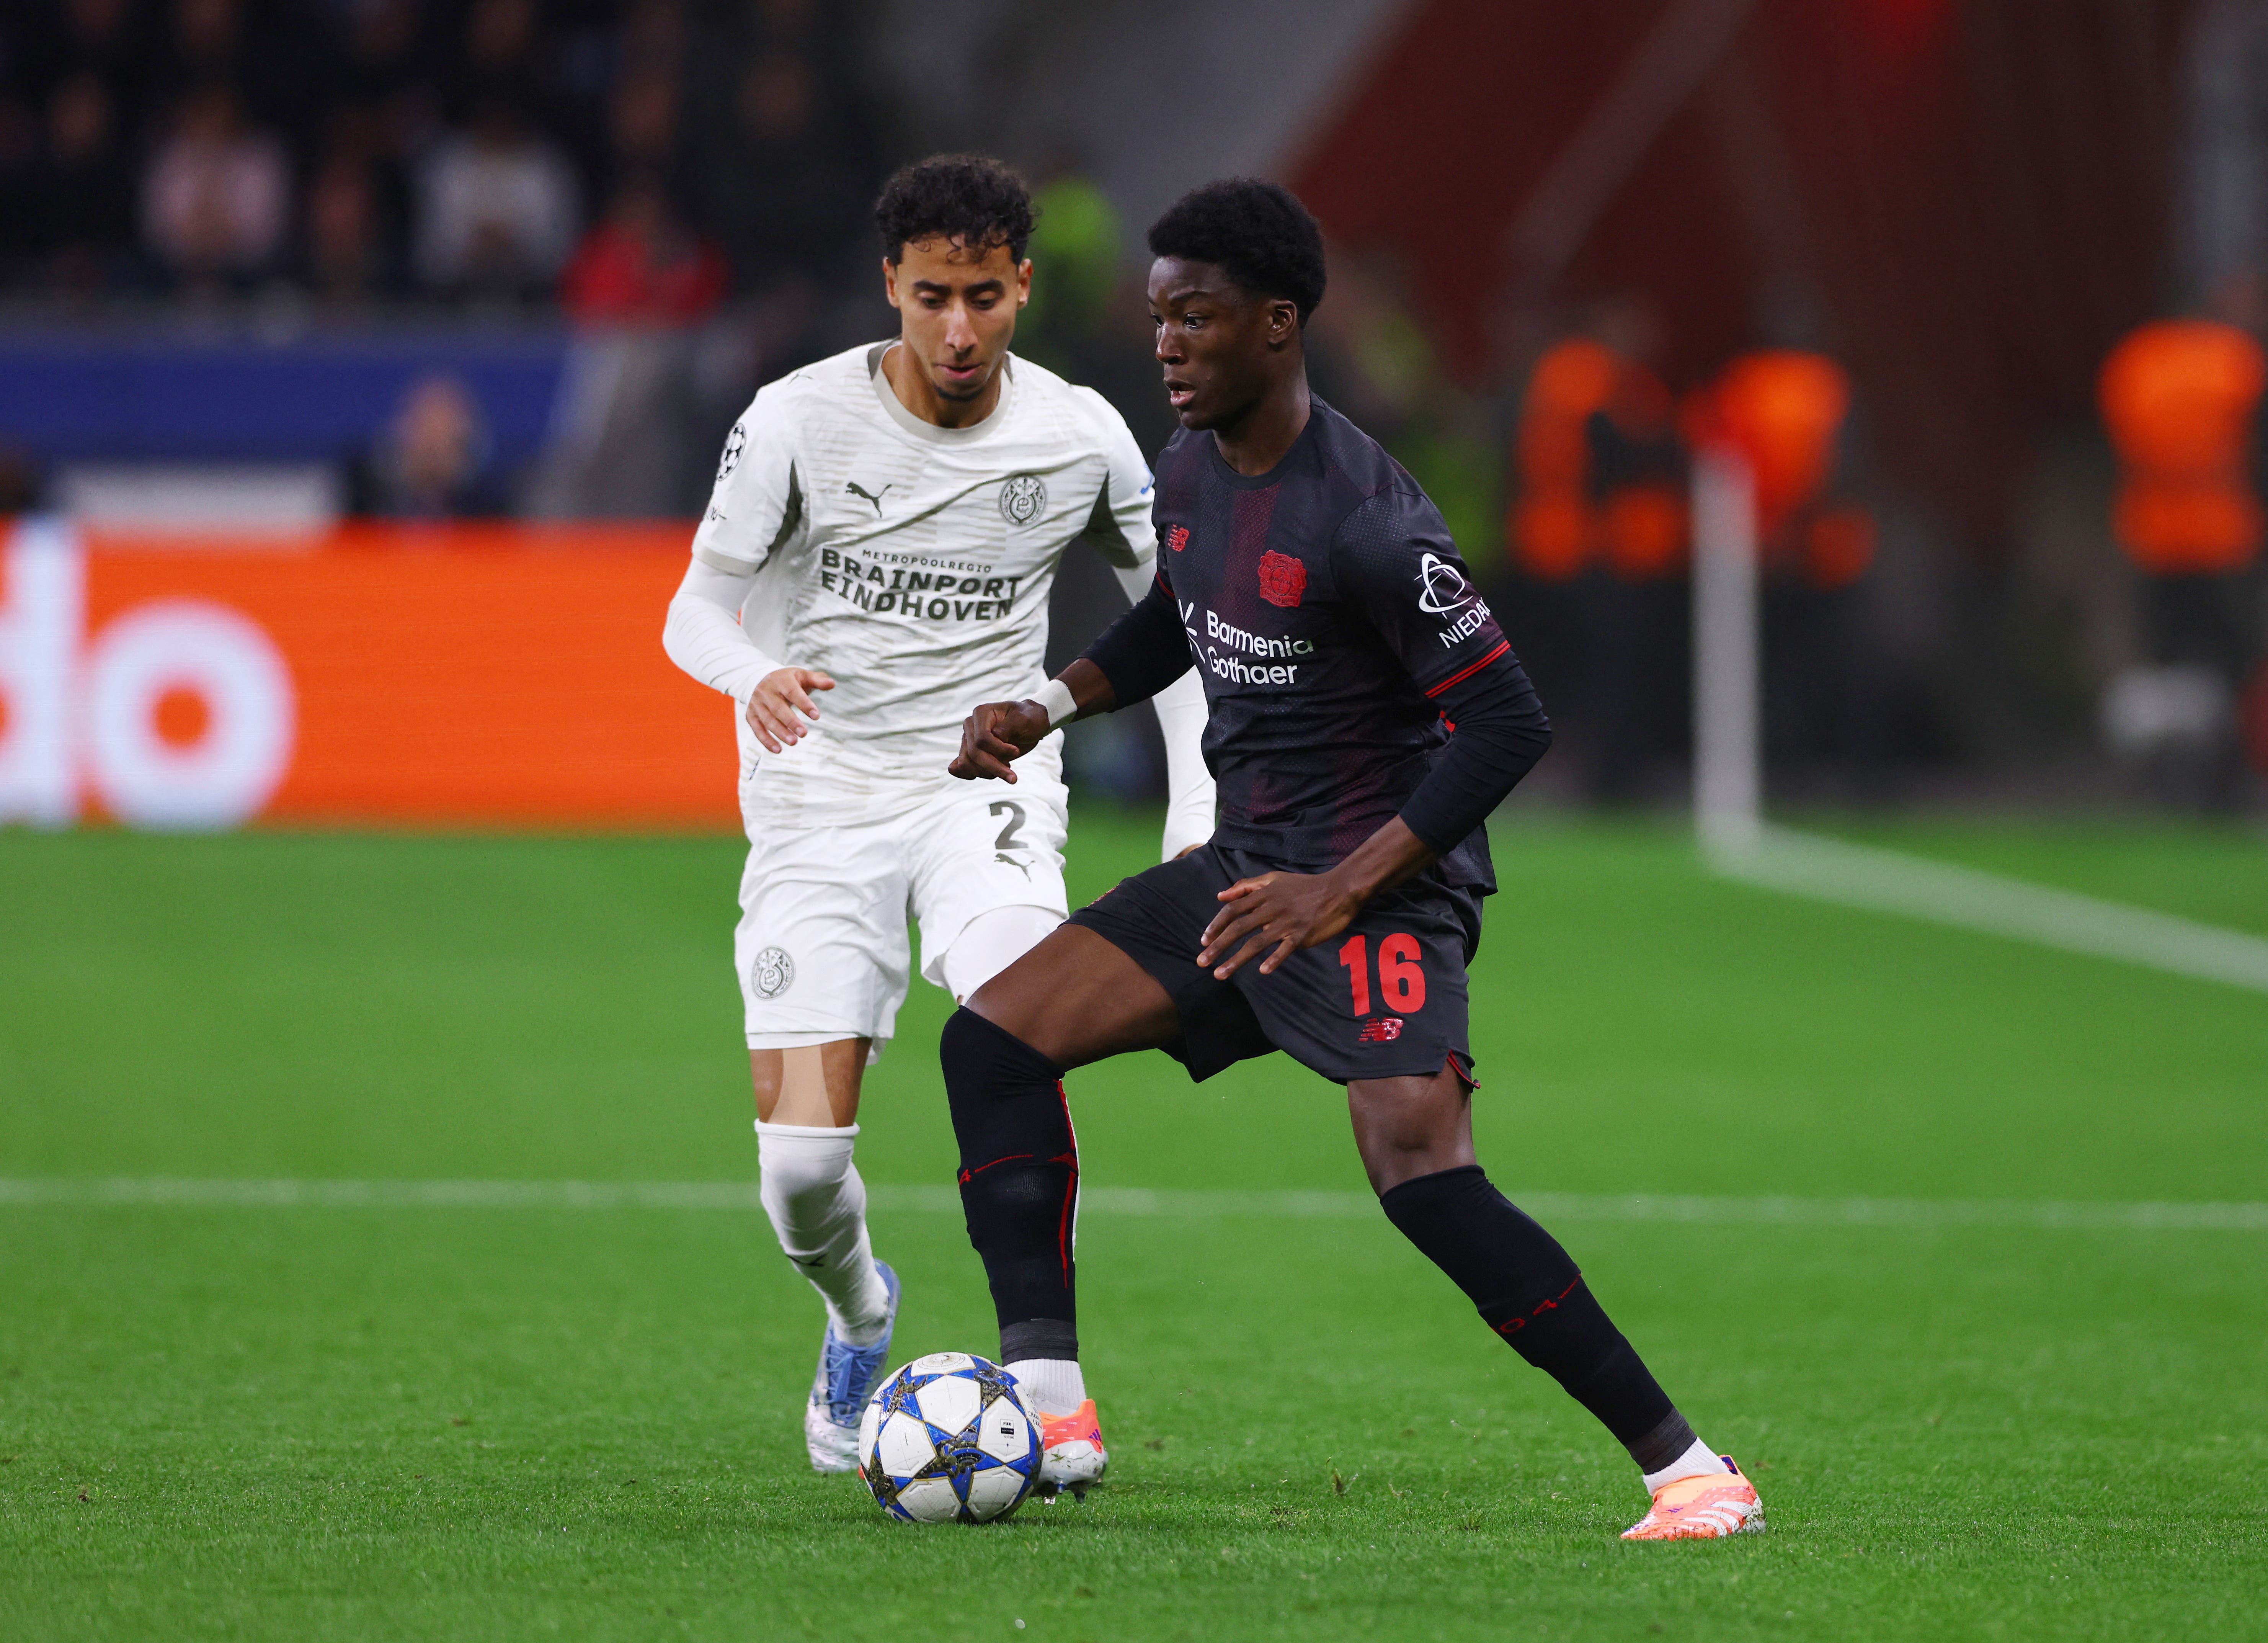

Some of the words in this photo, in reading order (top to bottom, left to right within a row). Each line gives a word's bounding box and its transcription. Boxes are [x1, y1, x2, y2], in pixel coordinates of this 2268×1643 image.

[822, 548, 1024, 598] BRAINPORT
[863, 549, 992, 573] METROPOOLREGIO
[821, 571, 1014, 621] EINDHOVEN
[1207, 610, 1314, 657] Barmenia
[1207, 646, 1298, 685] Gothaer
[989, 800, 1029, 850] 2
[1339, 932, 1427, 1017] 16
